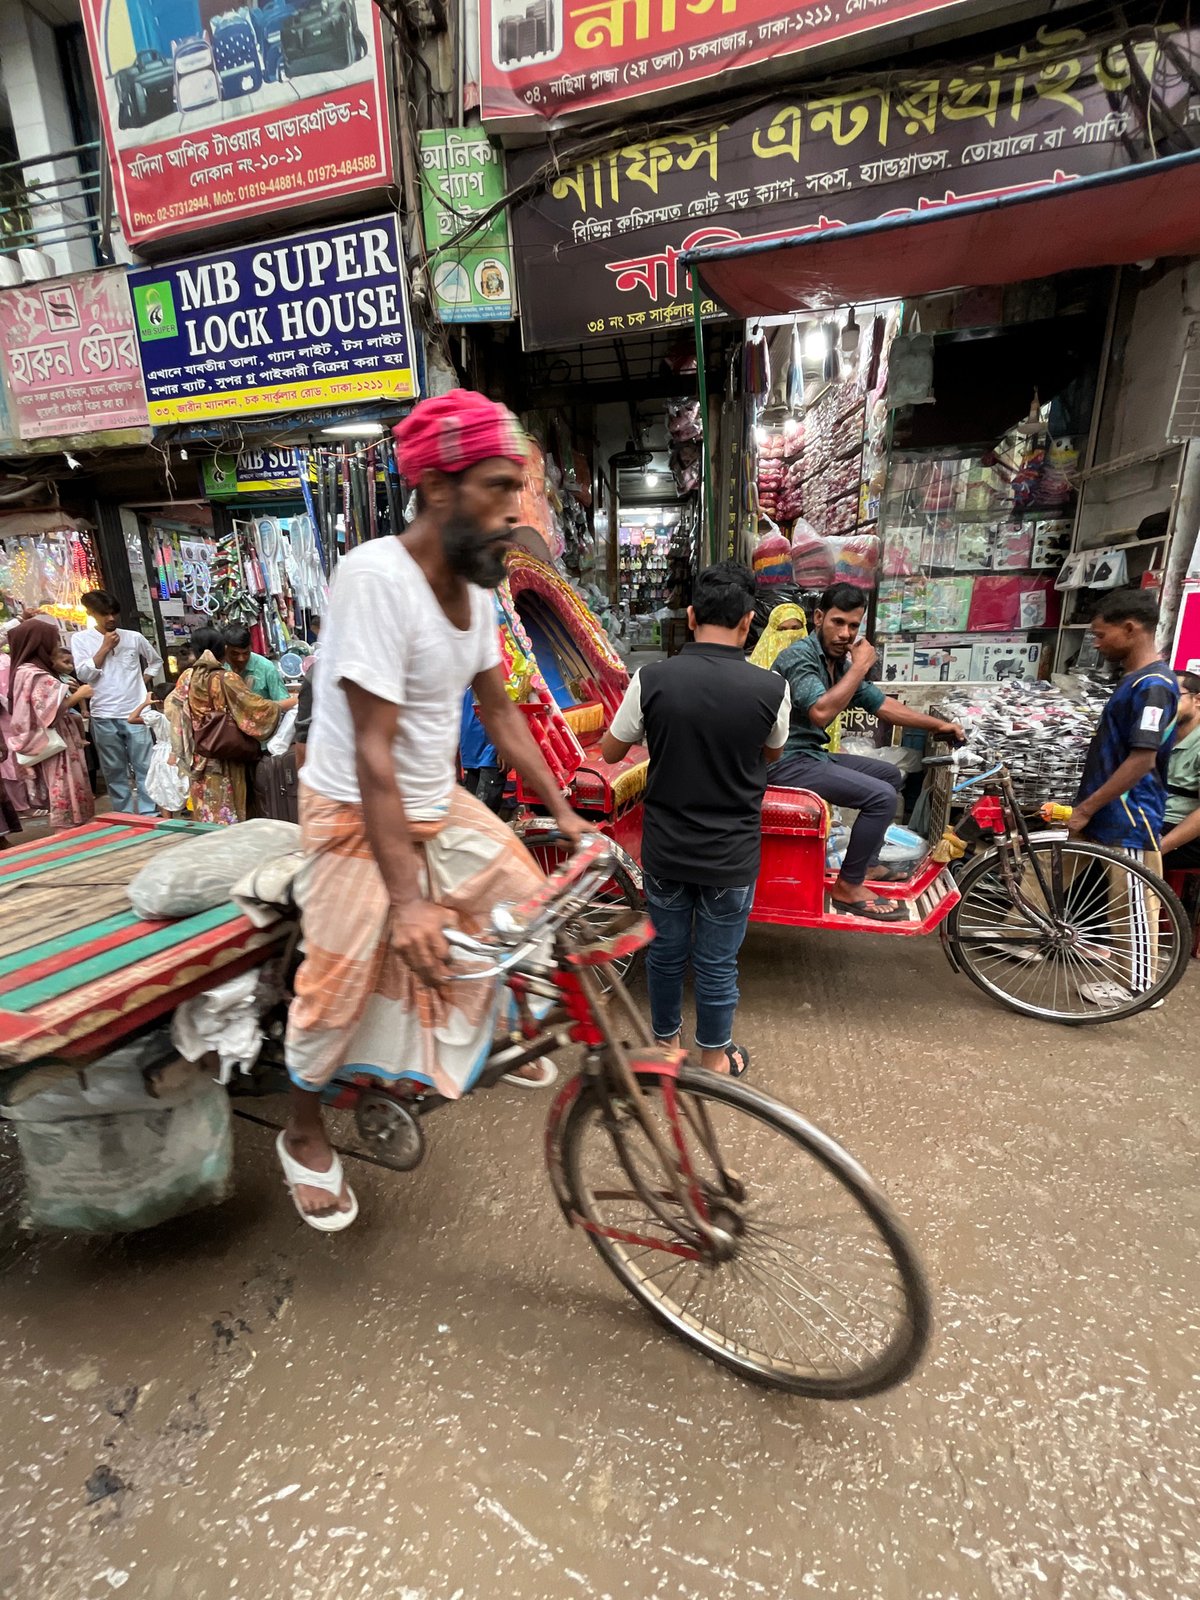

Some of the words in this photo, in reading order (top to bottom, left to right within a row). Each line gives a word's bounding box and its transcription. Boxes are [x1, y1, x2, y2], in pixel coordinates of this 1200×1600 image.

[524, 87, 547, 104] ৩৪,
[590, 67, 619, 90] প্লাজা
[651, 48, 684, 71] তলা)
[689, 29, 753, 61] চকবাজার,
[758, 5, 840, 40] ঢাকা-১২১১,
[128, 152, 164, 181] মদিনা
[166, 141, 210, 169] আশিক
[189, 164, 235, 188] দোকান
[133, 210, 156, 227] Pho:
[213, 188, 238, 207] Mob:
[238, 171, 307, 201] 01819-448814,
[307, 154, 377, 184] 01973-484588
[438, 171, 485, 199] ব্যাগ
[176, 260, 242, 313] MB
[251, 228, 399, 299] SUPER
[153, 325, 177, 335] SUPER
[185, 307, 274, 357] LOCK
[280, 284, 402, 342] HOUSE
[587, 318, 604, 333] ৩৪
[608, 316, 625, 330] নং
[627, 311, 646, 326] চক
[8, 340, 74, 385] হারুন
[147, 367, 182, 381] এখানে
[366, 332, 403, 349] লাইট
[150, 384, 179, 396] মশার
[259, 361, 309, 381] পাইকারী
[352, 355, 379, 368] করা
